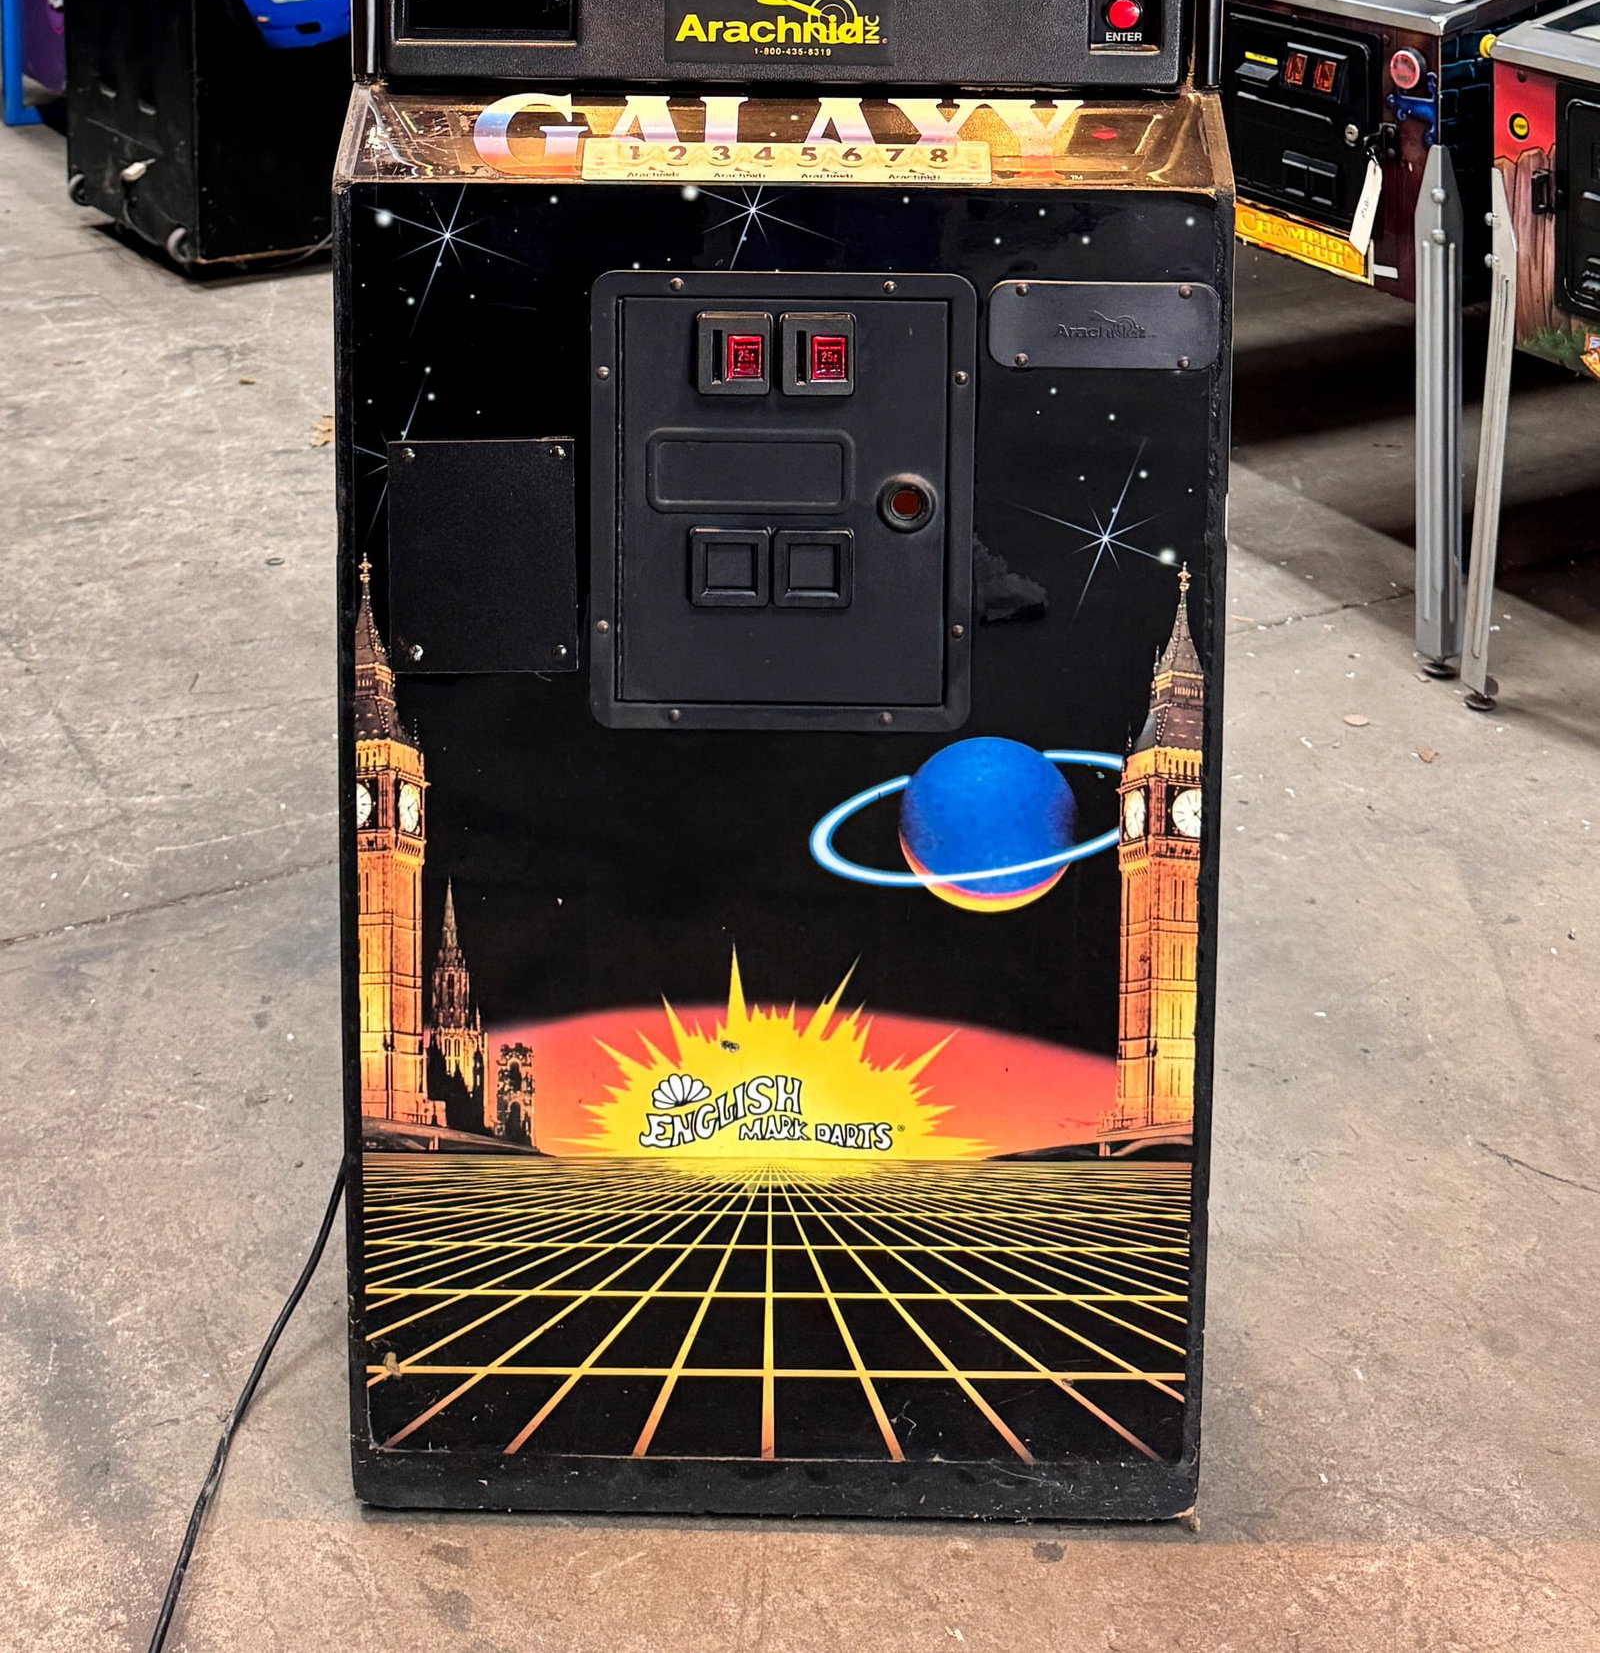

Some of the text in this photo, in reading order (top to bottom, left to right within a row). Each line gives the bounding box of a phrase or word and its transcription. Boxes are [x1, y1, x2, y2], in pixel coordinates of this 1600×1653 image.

[675, 14, 864, 44] Arachnid
[1105, 32, 1142, 42] ENTER
[754, 47, 832, 57] 1-800-435-8319
[667, 146, 687, 160] 2
[712, 146, 731, 160] 3
[754, 147, 775, 160] 4
[800, 147, 818, 161] 5
[841, 147, 862, 161] 6
[886, 148, 905, 162] 7
[930, 148, 948, 162] 8
[639, 1074, 803, 1148] ENGLISH
[738, 1115, 892, 1150] MARK DARTS
